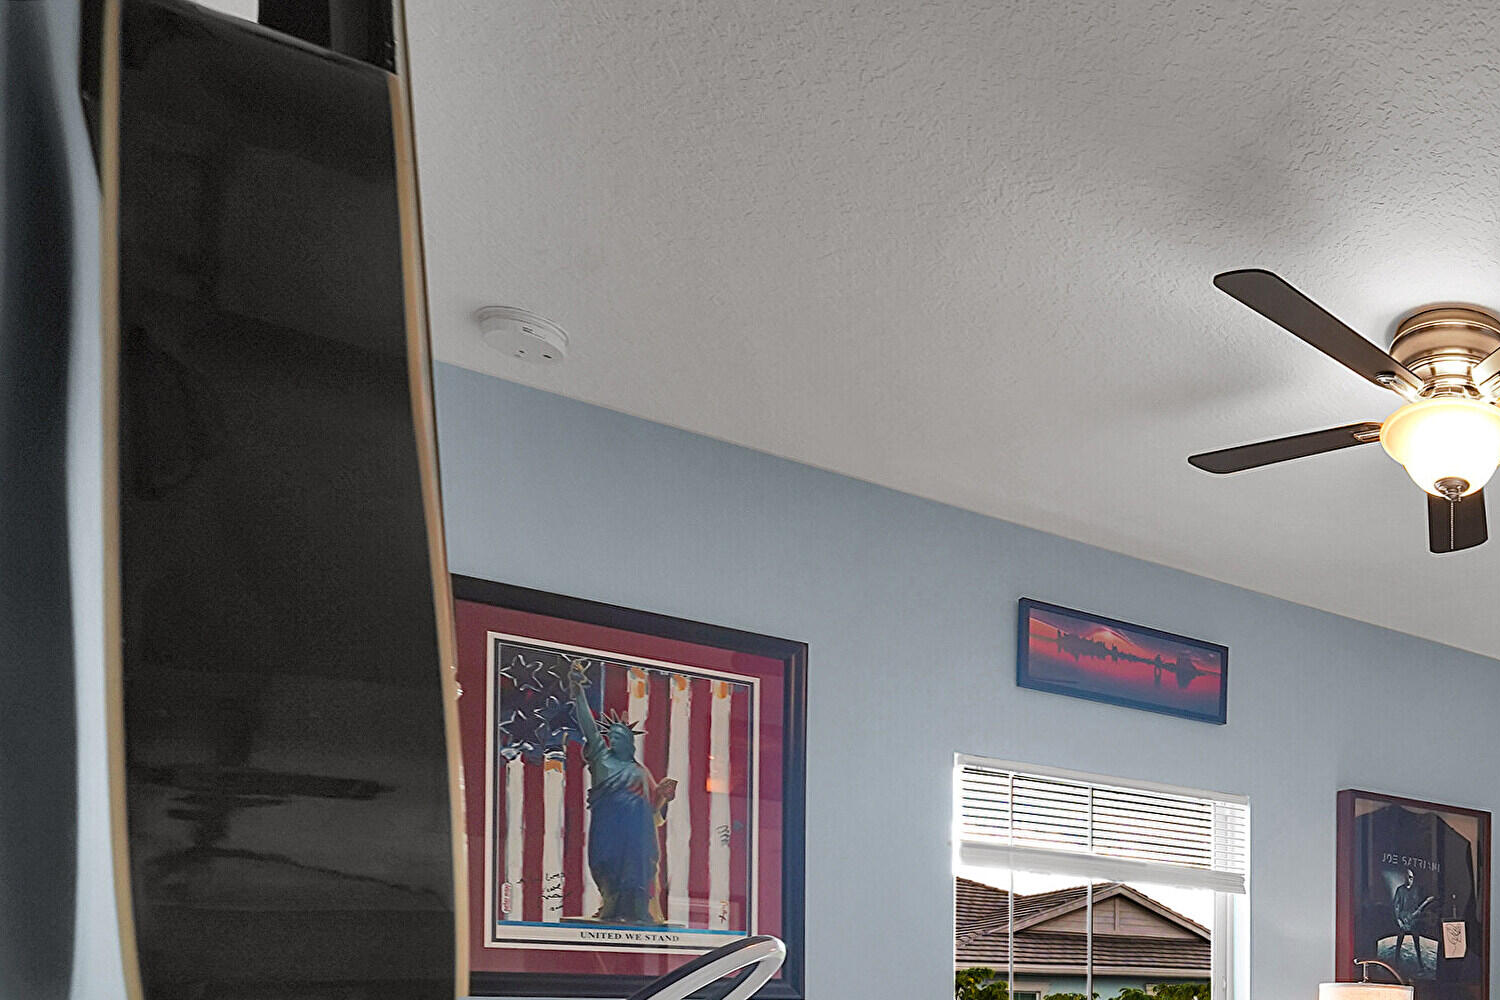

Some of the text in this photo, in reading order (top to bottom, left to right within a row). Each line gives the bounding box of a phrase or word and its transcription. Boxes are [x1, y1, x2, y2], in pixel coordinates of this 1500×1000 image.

[1382, 852, 1398, 864] JOE
[580, 931, 680, 942] UNITED WE STAND
